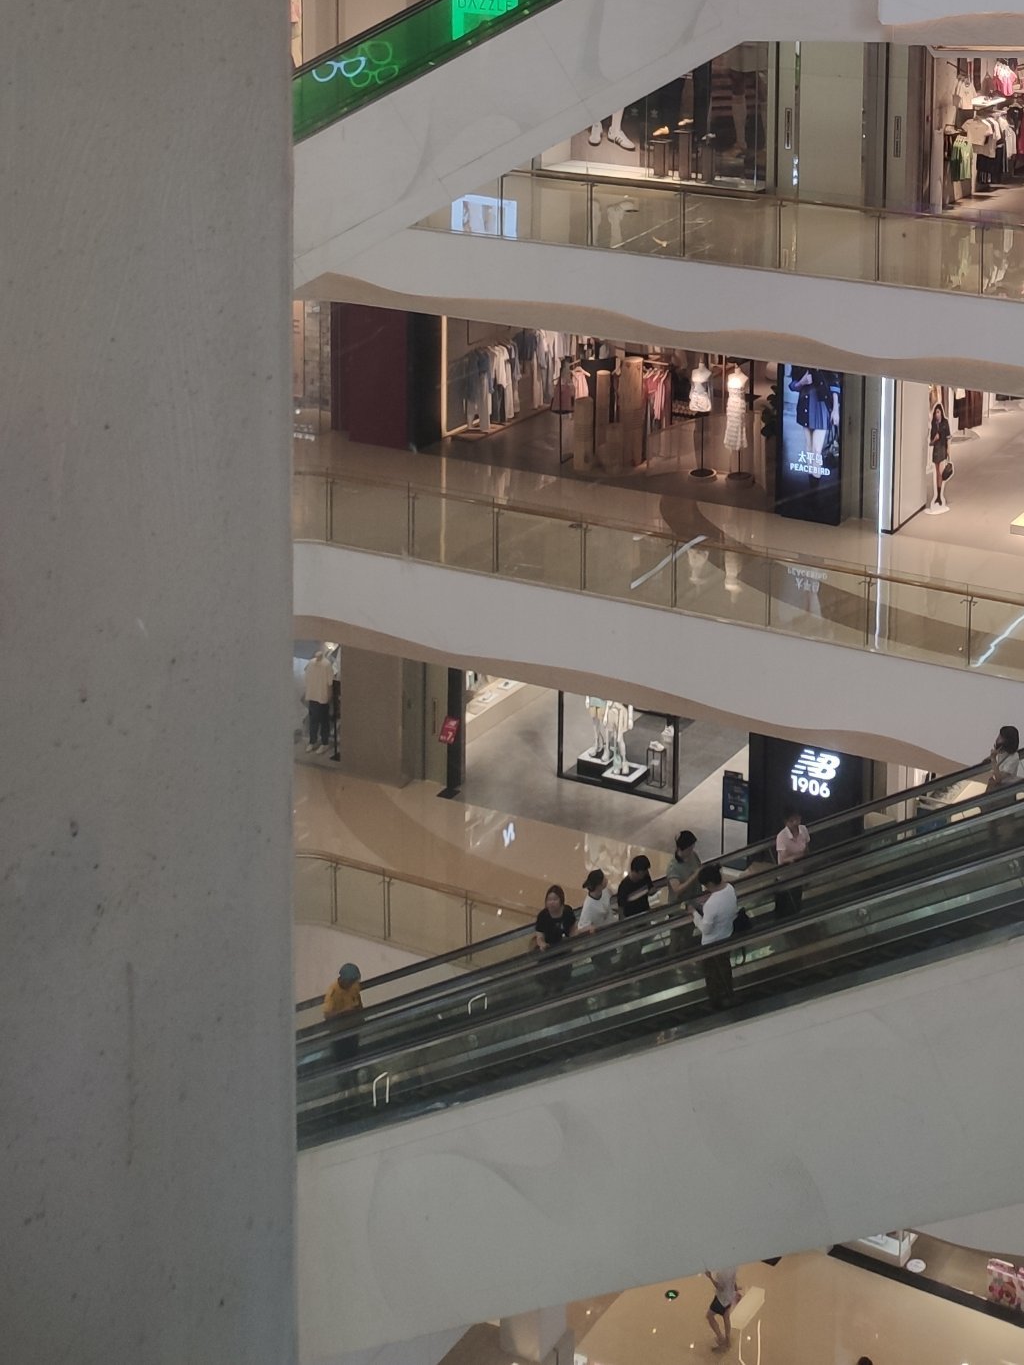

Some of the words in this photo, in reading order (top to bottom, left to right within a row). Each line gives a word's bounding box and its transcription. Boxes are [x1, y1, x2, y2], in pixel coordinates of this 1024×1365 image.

[798, 451, 823, 466] 太平鸟
[789, 462, 831, 476] PEACEBIRD
[790, 775, 831, 798] 1906
